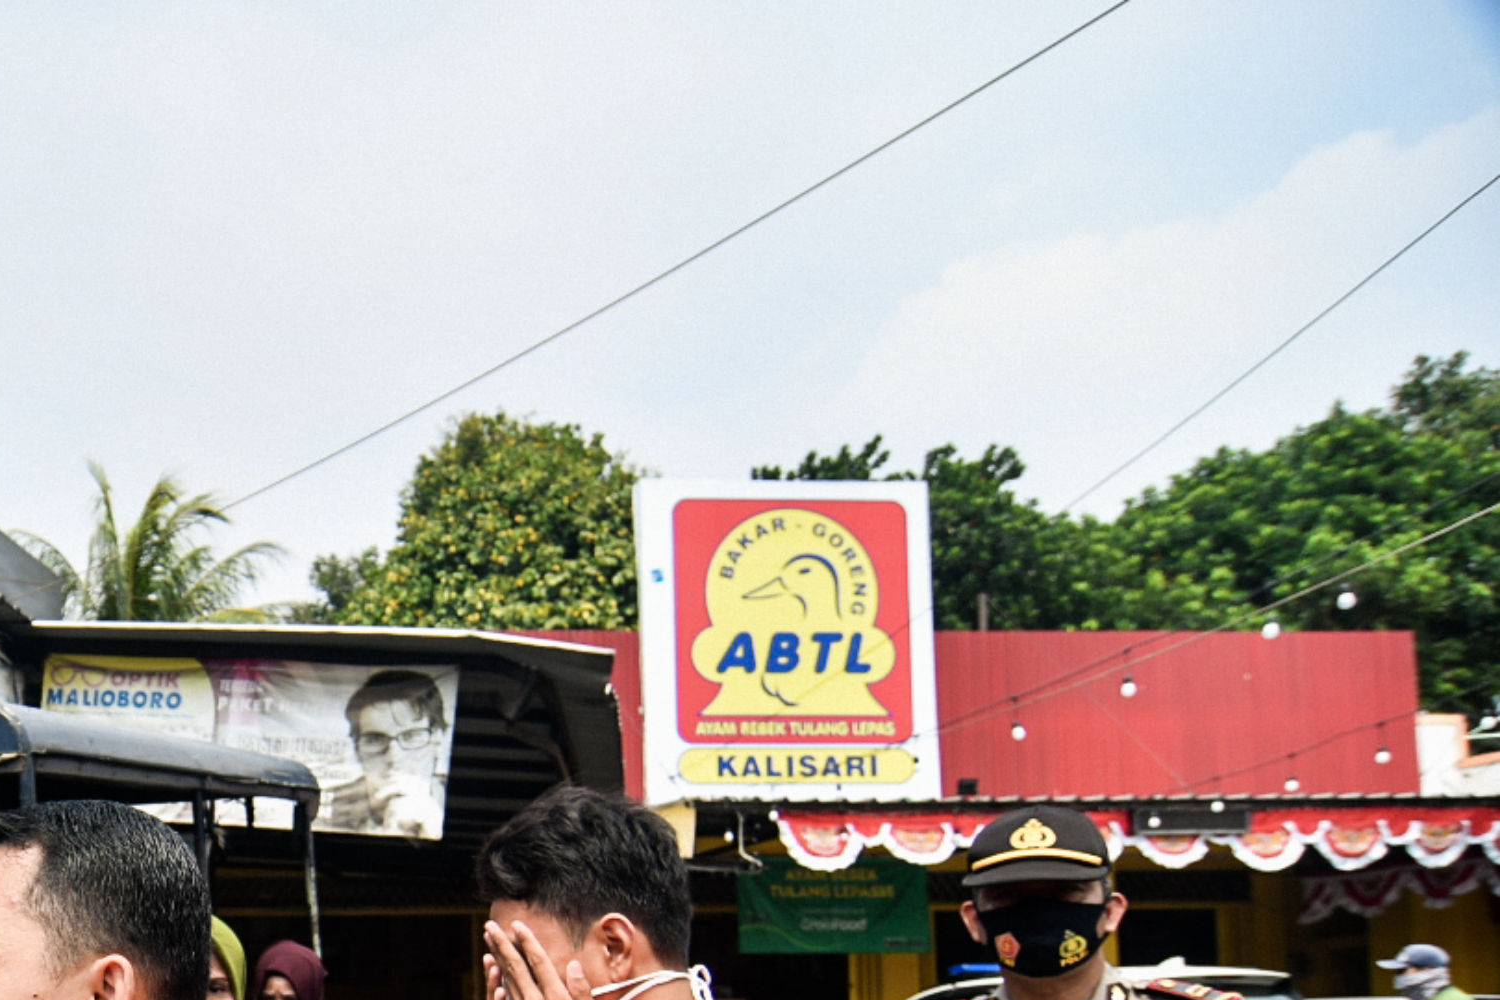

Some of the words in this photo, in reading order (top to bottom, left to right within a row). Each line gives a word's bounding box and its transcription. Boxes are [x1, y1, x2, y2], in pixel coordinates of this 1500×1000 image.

[720, 517, 786, 579] BAKAR
[812, 522, 868, 616] GORENG
[716, 632, 872, 674] ABTL
[46, 687, 182, 709] MALIOBORO
[790, 721, 849, 736] TULANG
[852, 721, 896, 737] LEPAS
[717, 755, 878, 778] KALISARI
